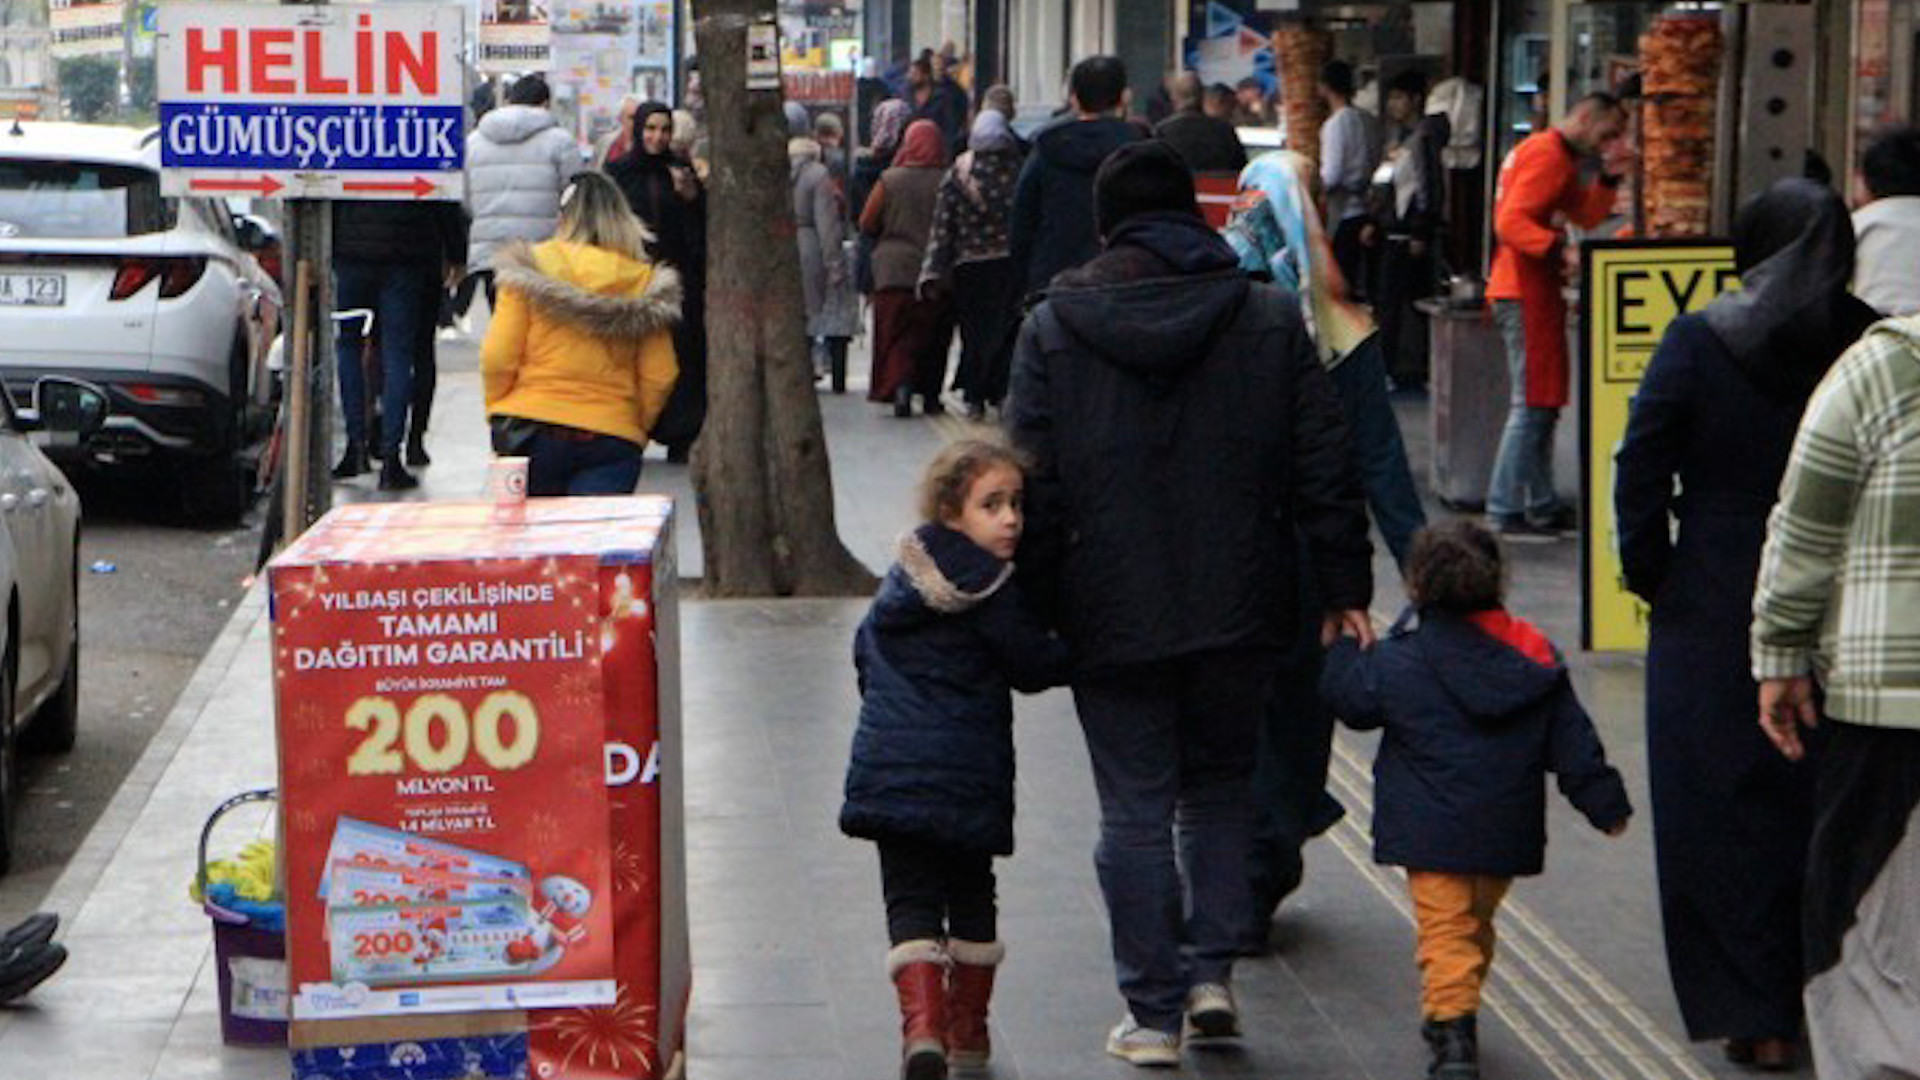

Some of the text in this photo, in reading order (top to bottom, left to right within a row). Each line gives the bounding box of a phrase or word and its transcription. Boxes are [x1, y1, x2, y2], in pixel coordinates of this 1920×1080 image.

[185, 14, 438, 95] HELİN
[169, 105, 457, 168] GÜMÜŞÇÜLÜK
[27, 278, 58, 297] 123
[319, 581, 554, 611] YILBAŞI ÇEKİLİŞİNDE
[378, 611, 498, 638] TAMAMI
[294, 630, 583, 670] DAĞITIM GARANTİLİ
[344, 689, 540, 776] 200
[396, 775, 495, 794] MİLYON TL
[353, 931, 413, 958] 200
